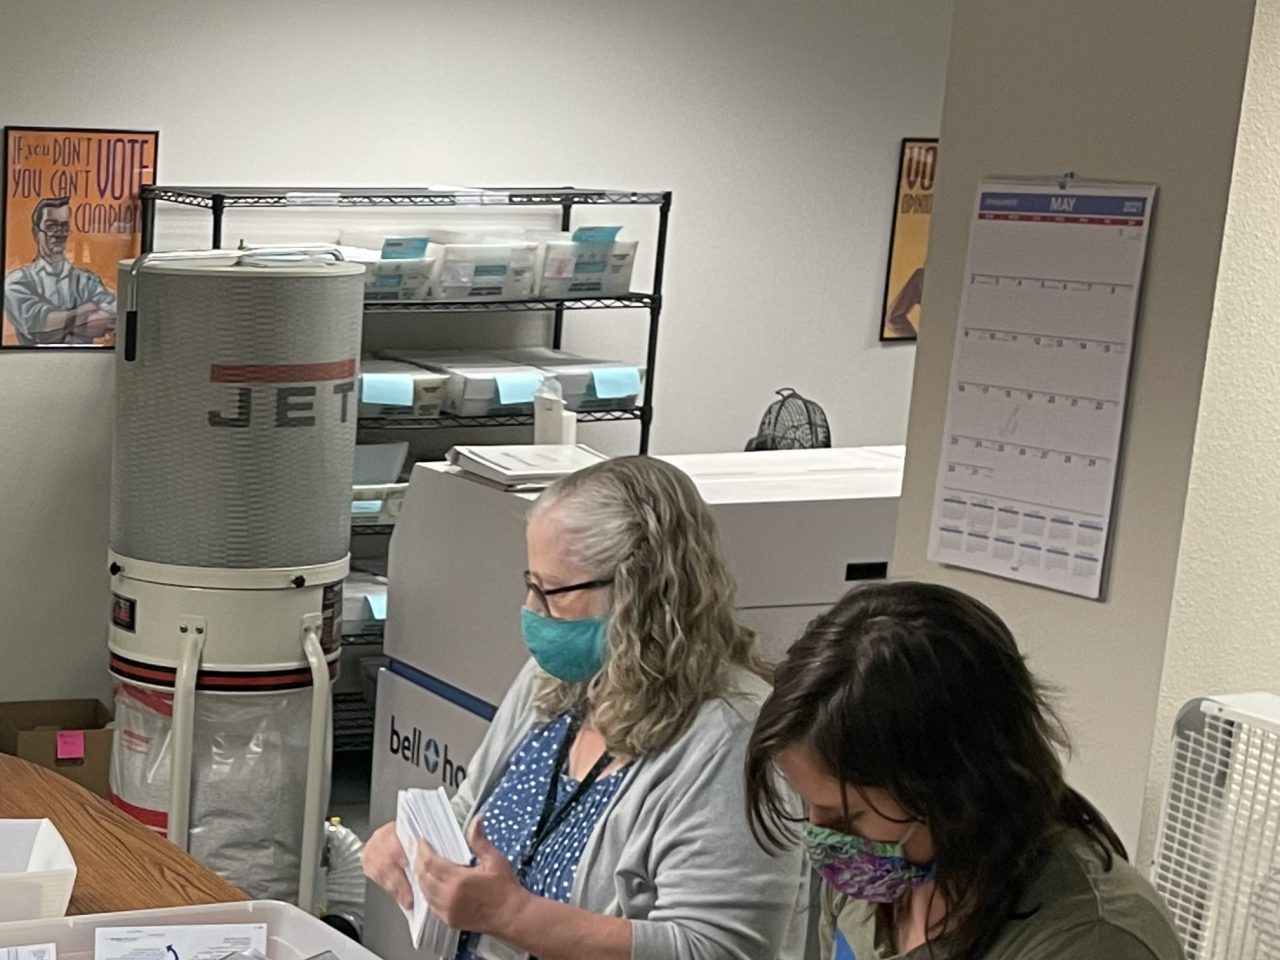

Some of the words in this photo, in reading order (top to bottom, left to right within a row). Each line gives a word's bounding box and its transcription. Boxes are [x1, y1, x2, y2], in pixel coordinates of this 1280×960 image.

[12, 168, 43, 198] YOU
[50, 170, 92, 198] CAN'T
[13, 136, 24, 165] IF
[53, 137, 92, 167] DON'T
[96, 138, 150, 200] VOTE
[1050, 197, 1077, 212] MAY
[208, 381, 355, 428] JET
[390, 714, 422, 768] bell
